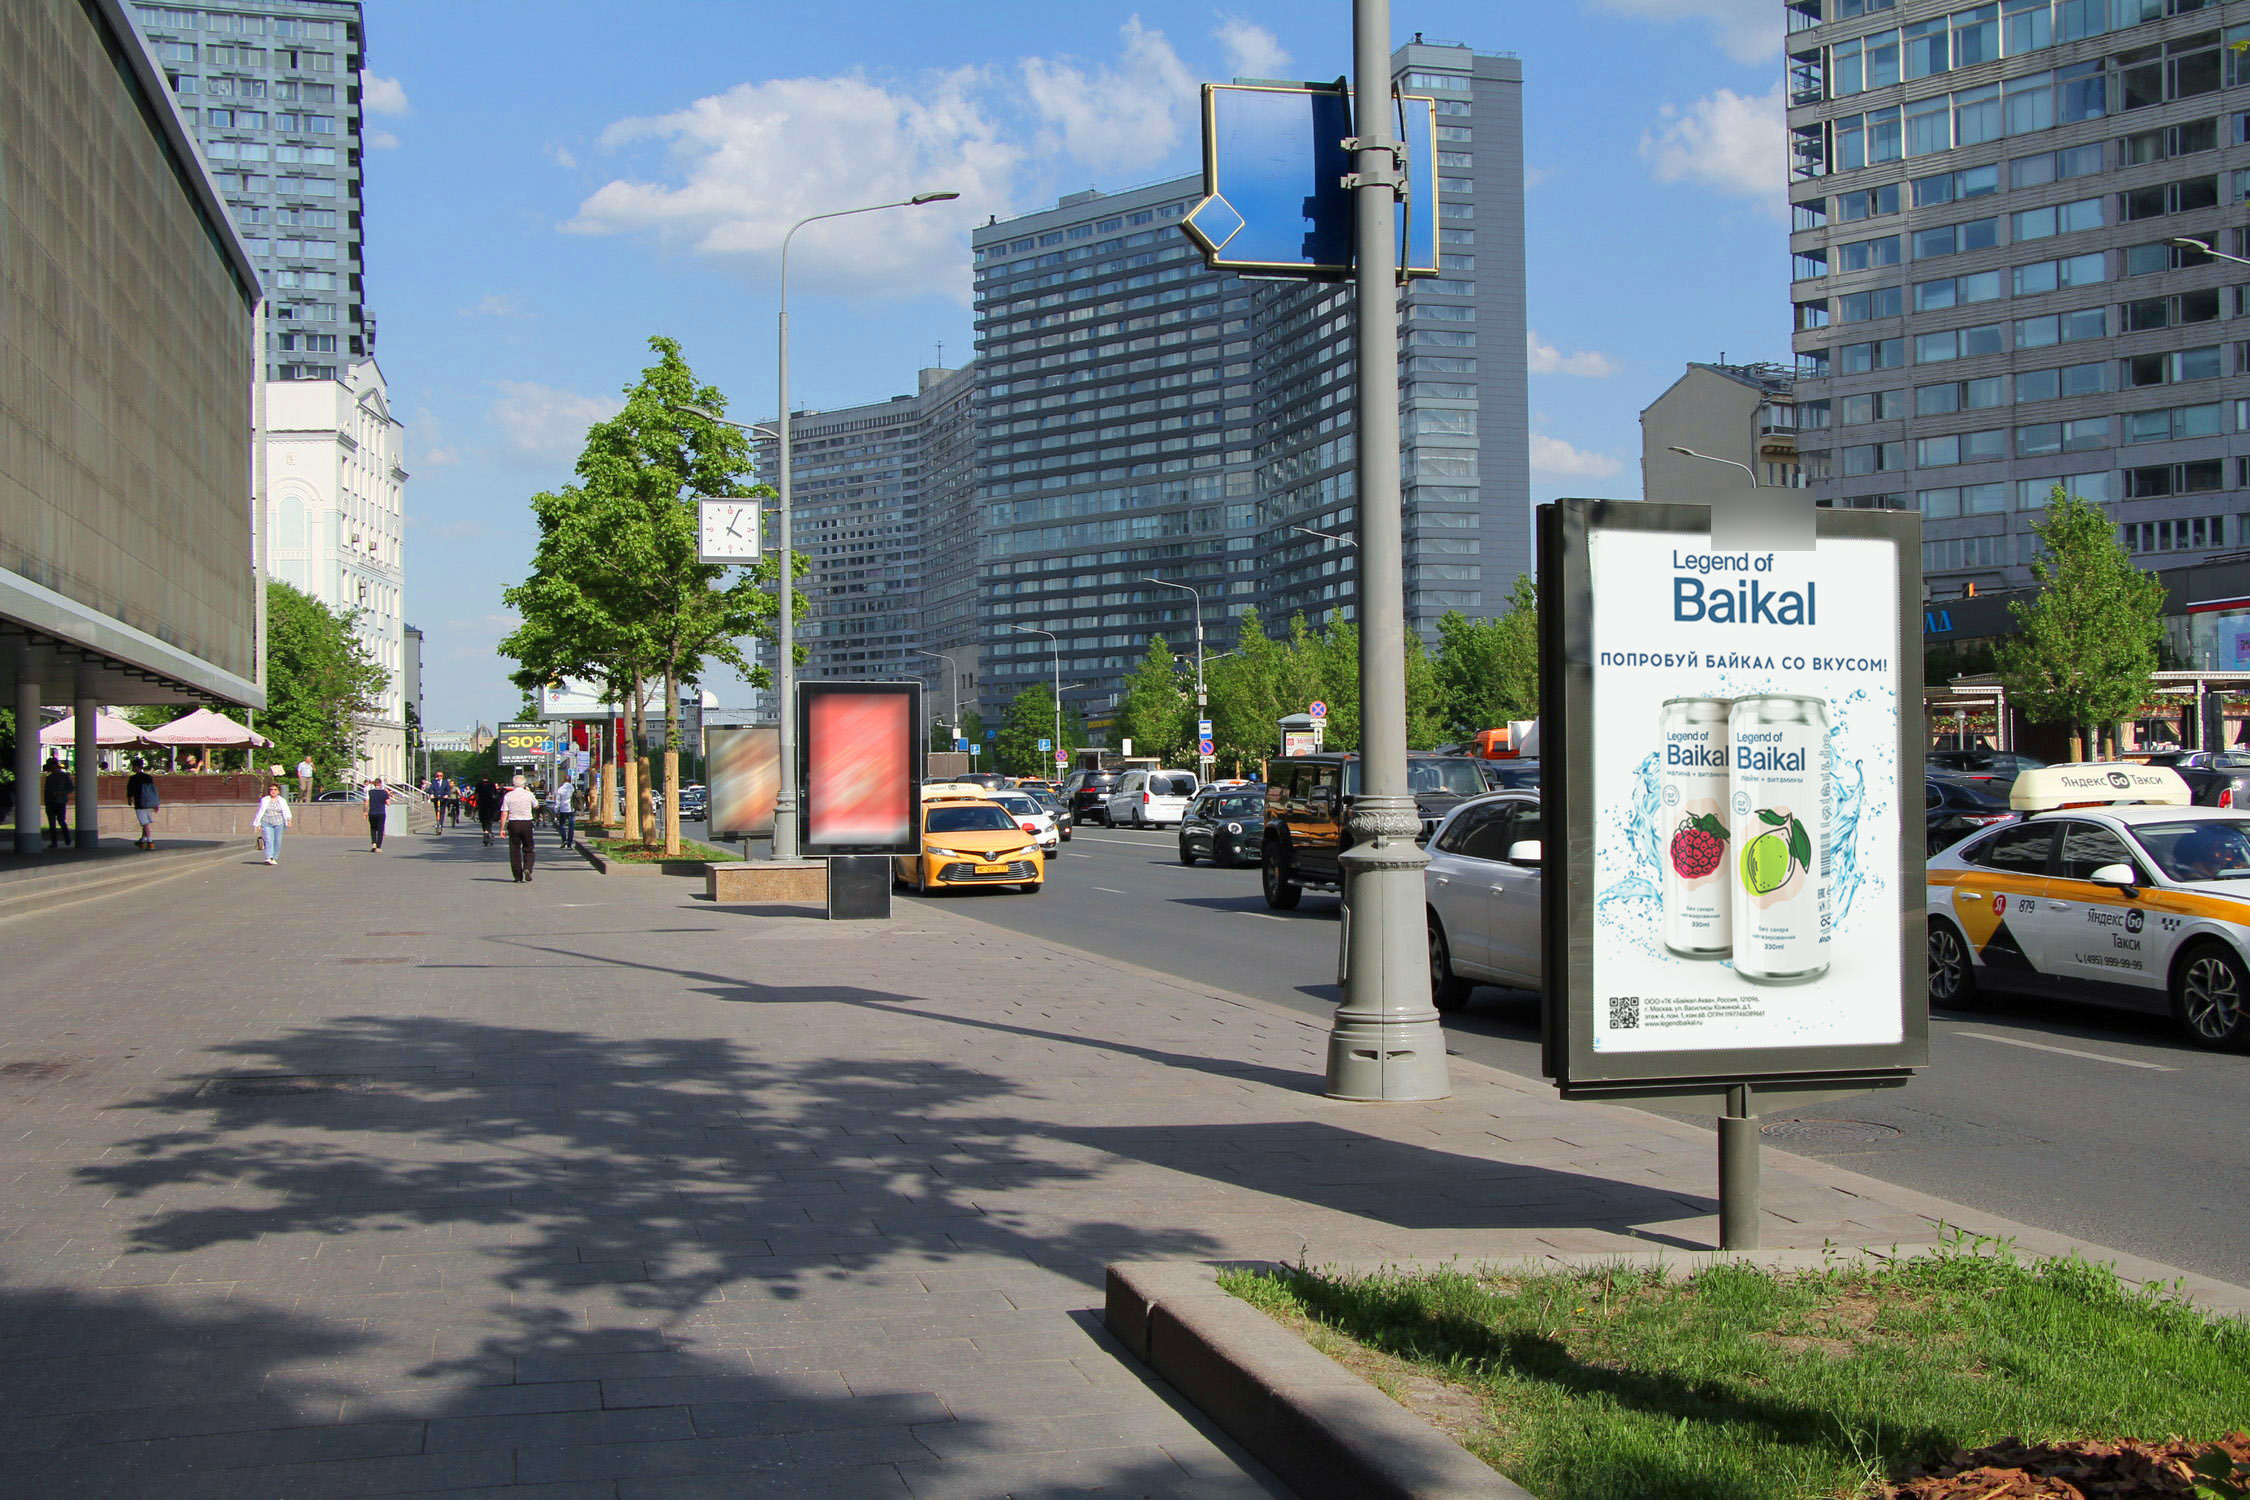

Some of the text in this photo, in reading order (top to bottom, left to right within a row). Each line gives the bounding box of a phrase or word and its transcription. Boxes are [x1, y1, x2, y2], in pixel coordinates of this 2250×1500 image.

[1673, 550, 1774, 574] Legend of
[1673, 576, 1816, 626] Baikal
[1600, 652, 1888, 672] ПОПРОБУЙ БАЙКАЛ СО ВКУСОМ!
[1666, 731, 1709, 742] Legend of
[1737, 732, 1783, 744] Legend of
[1667, 744, 1728, 766] Baikal
[1737, 746, 1805, 772] Baikal
[2060, 774, 2164, 788] Яндекс Go Такси
[1994, 896, 2004, 912] Я
[2018, 900, 2035, 914] 879
[2088, 908, 2142, 930] Яндекс Go
[2112, 932, 2141, 951] Такси
[2084, 954, 2142, 970] (495) 999-99-99
